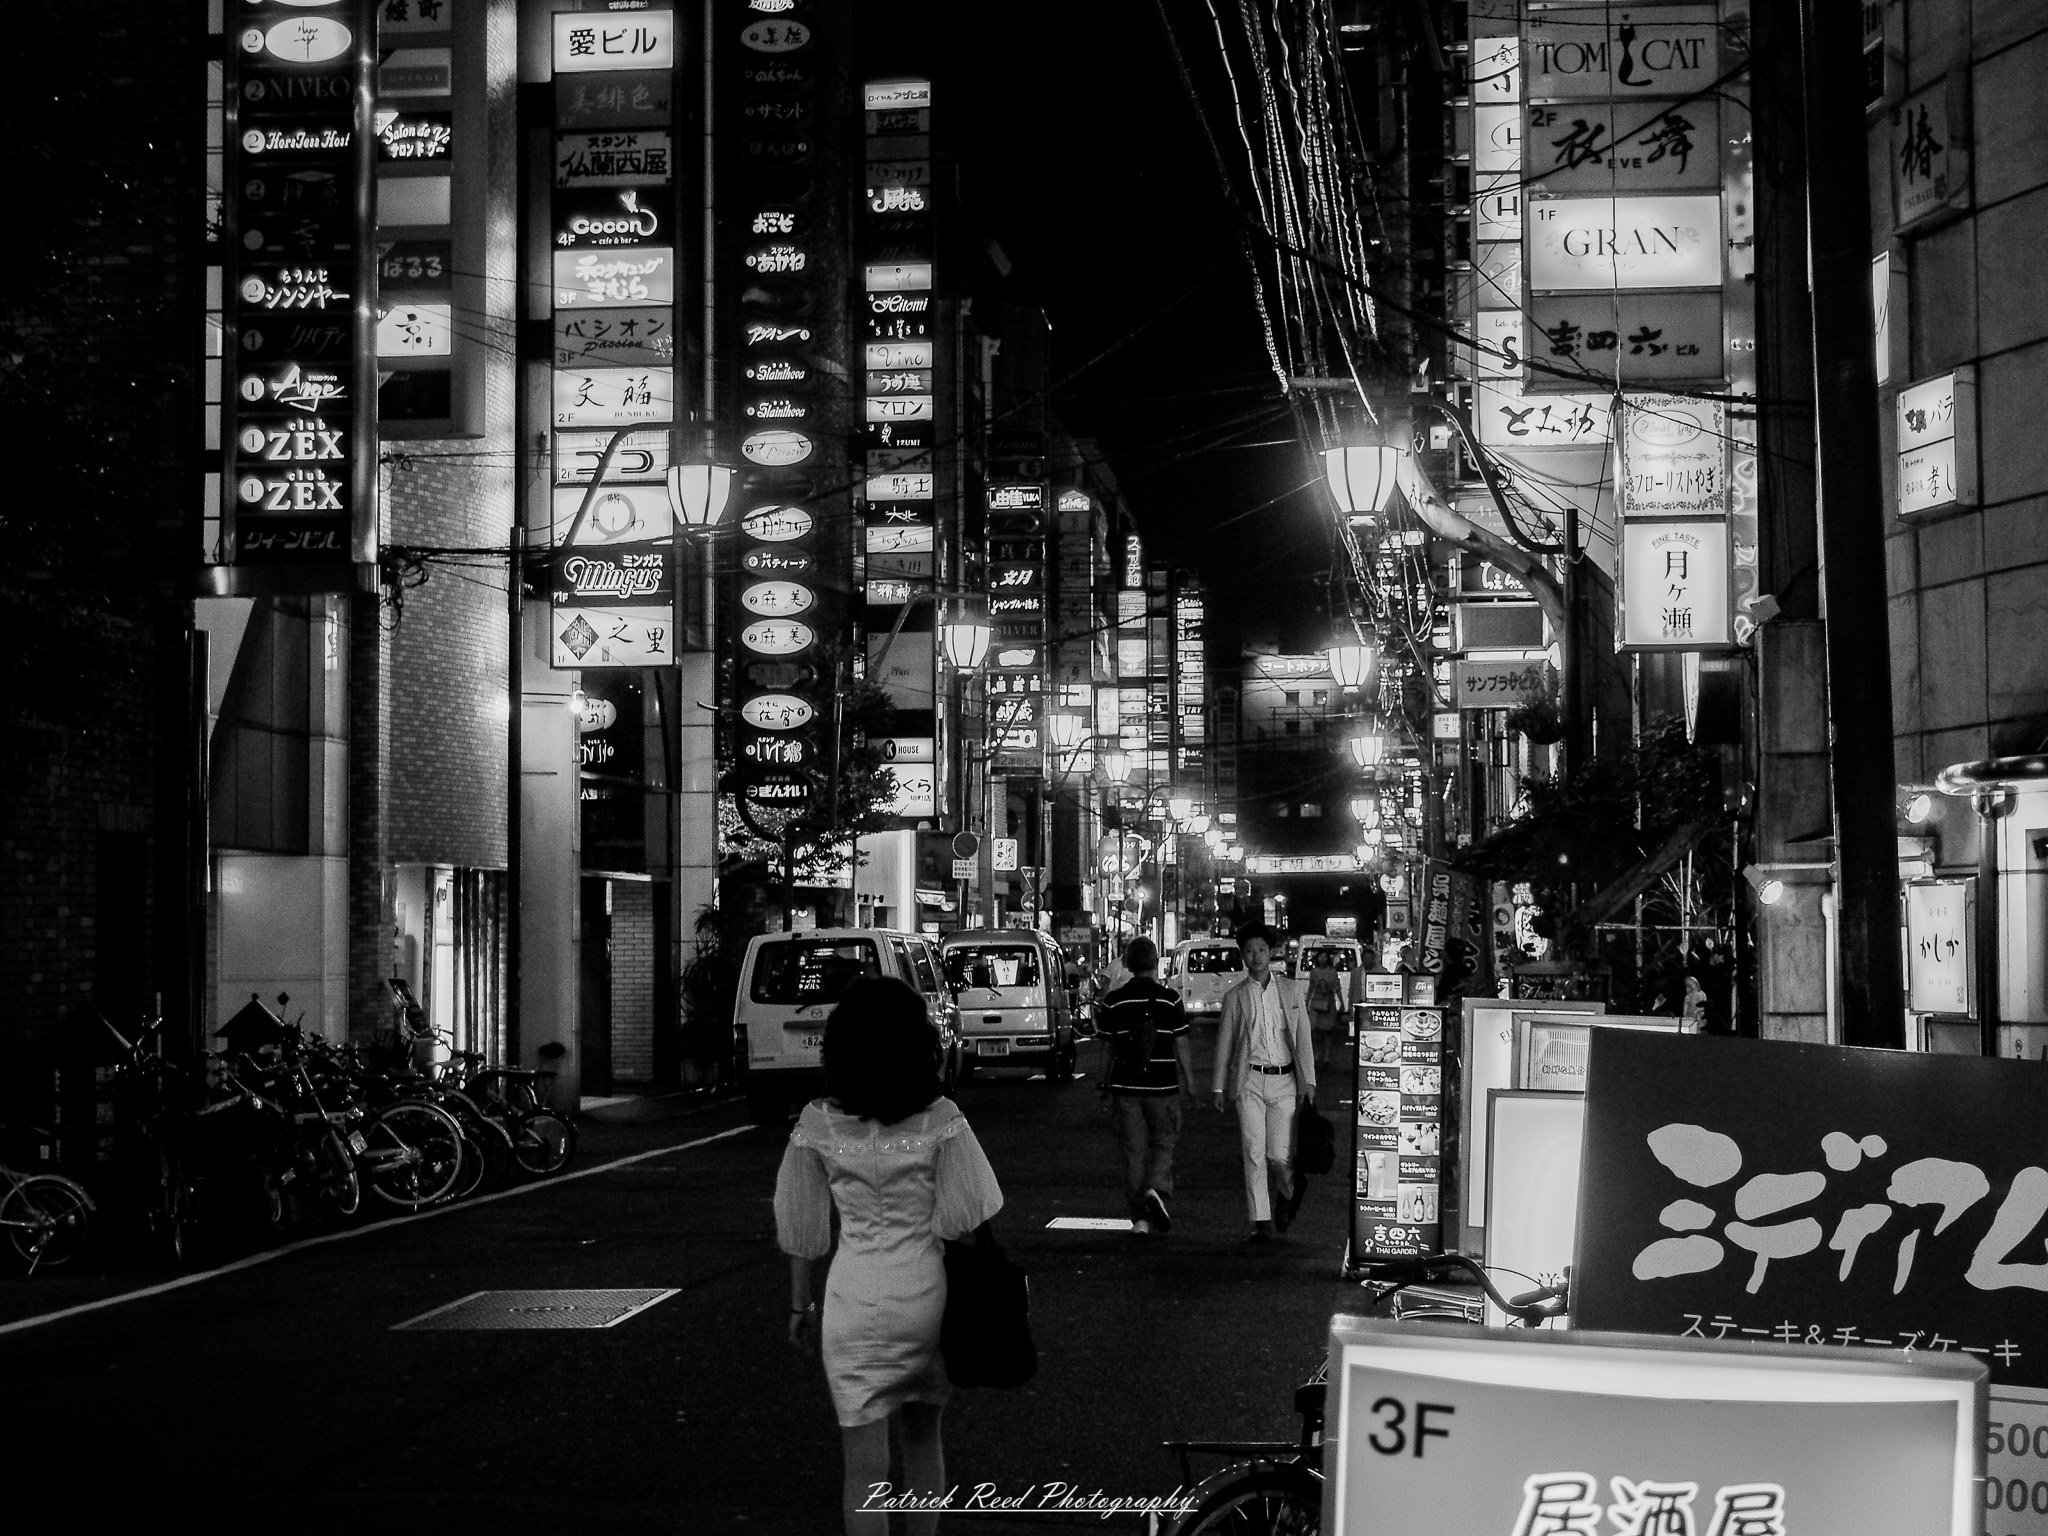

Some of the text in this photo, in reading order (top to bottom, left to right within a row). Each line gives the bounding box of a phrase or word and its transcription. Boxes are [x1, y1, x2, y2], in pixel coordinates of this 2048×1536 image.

[569, 27, 657, 56] 愛ビル
[1536, 42, 1610, 74] TOM
[1642, 38, 1705, 71] CAT
[1531, 108, 1557, 127] 2F
[588, 136, 637, 149] スタンド
[1900, 103, 1943, 185] 椿
[560, 149, 667, 177] 仏蘭西屋
[1607, 157, 1642, 170] EVE
[1537, 208, 1557, 221] 1F
[558, 233, 575, 247] 4F
[1562, 225, 1681, 258] GRAN
[757, 252, 806, 273] あかね
[587, 276, 648, 303] きむら
[559, 292, 577, 305] 3F
[872, 295, 929, 313] Hitomi
[565, 318, 665, 338] パシオン
[559, 350, 575, 363] 3F
[614, 410, 659, 418] BUNBUKU
[876, 400, 924, 416] マロン
[288, 418, 327, 431] club
[558, 412, 575, 423] 2F
[268, 432, 344, 461] ZEX
[594, 435, 634, 448] STND
[896, 438, 921, 447] IZUMI
[288, 468, 326, 481] club
[1635, 465, 1717, 495] フローリストやぎ
[267, 482, 343, 511] ZEX
[1651, 531, 1702, 548] FINE TASTE
[622, 554, 664, 568] ミンガス
[1186, 706, 1202, 714] TRY
[898, 745, 919, 754] HOUSE
[1375, 1246, 1418, 1255] THAI GARDEN
[1367, 1397, 1456, 1459] 3F
[1511, 1470, 1786, 1536] 居酒屋
